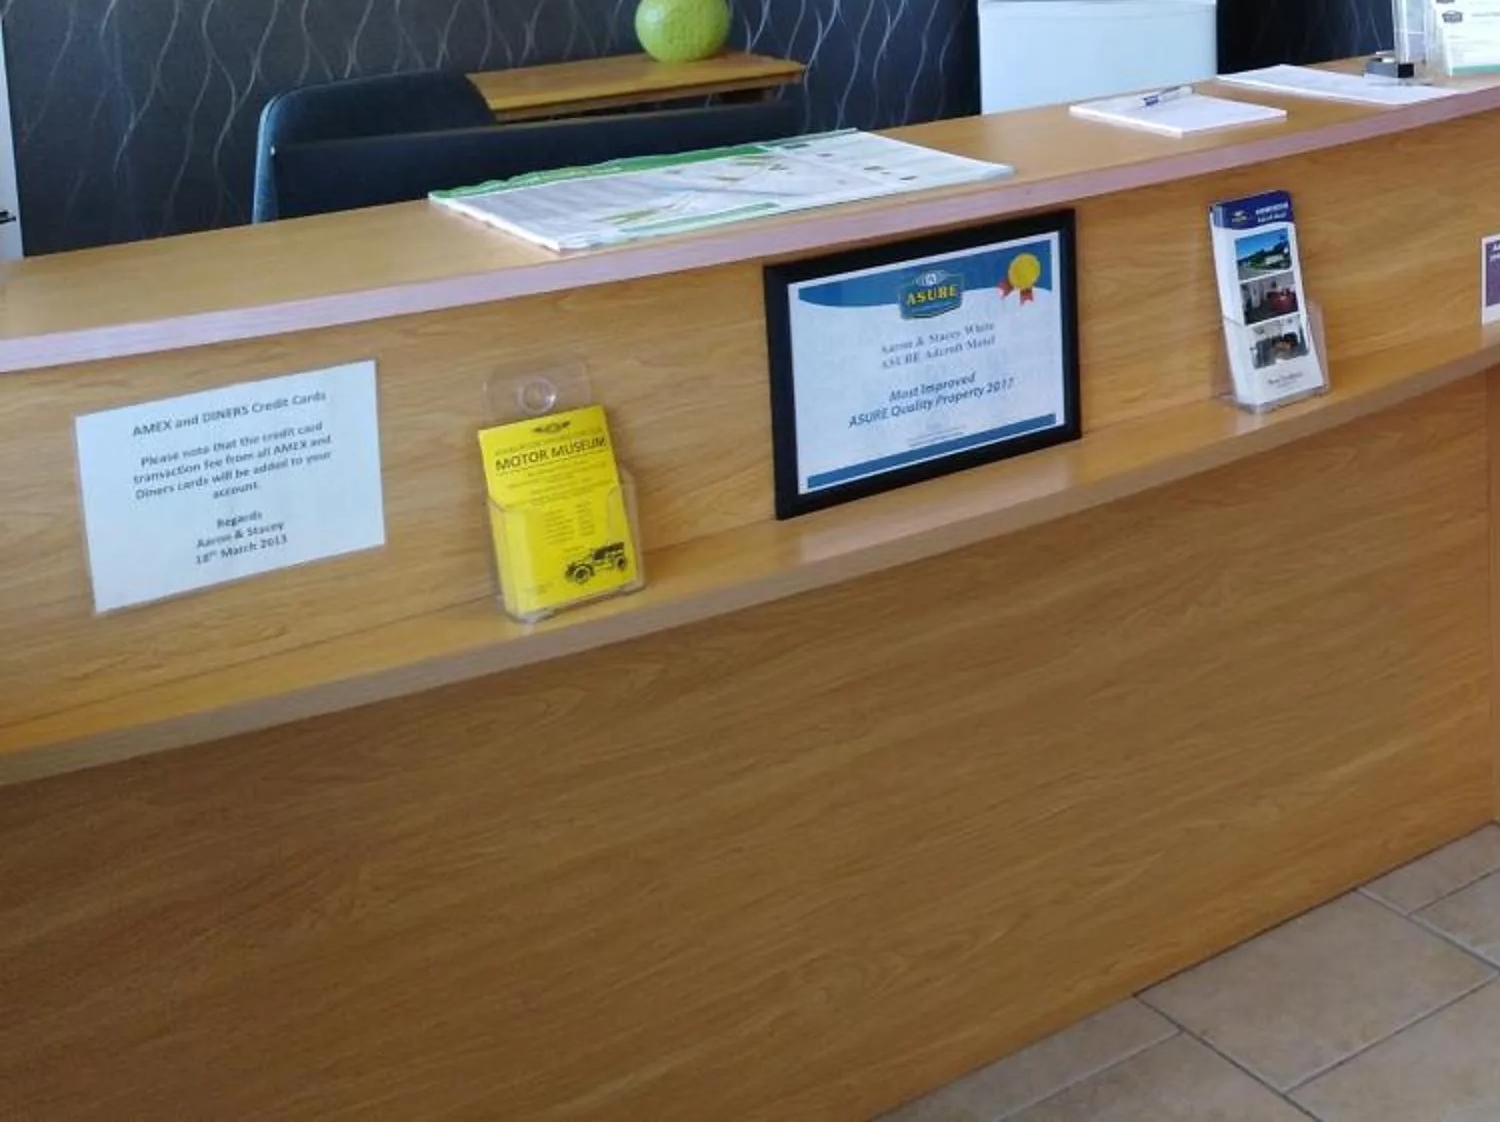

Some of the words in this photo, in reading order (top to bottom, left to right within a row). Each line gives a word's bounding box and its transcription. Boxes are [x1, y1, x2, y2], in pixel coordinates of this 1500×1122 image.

[906, 285, 959, 306] ASURE
[915, 336, 924, 348] &
[848, 408, 888, 428] ASURE
[891, 397, 933, 417] Quality
[935, 388, 984, 406] Property
[986, 378, 1014, 394] 2017
[889, 385, 919, 402] Most
[920, 373, 976, 395] Improved
[133, 421, 171, 437] AMEX
[176, 416, 199, 428] and
[203, 407, 249, 424] DINERS
[251, 398, 288, 414] Credit
[292, 390, 326, 407] Cards
[133, 462, 200, 484] transaction
[204, 457, 223, 471] fee
[226, 451, 253, 466] from
[257, 446, 270, 459] all
[273, 439, 307, 455] AMEX
[310, 434, 331, 447] and
[141, 451, 178, 467] Please
[183, 446, 210, 458] note
[214, 438, 237, 452] that
[240, 434, 260, 447] the
[263, 427, 294, 442] credit
[298, 422, 322, 436] card
[496, 448, 549, 471] MOTOR
[551, 437, 605, 457] MUSEUM
[136, 482, 174, 500] Diners
[177, 477, 208, 492] cards
[211, 471, 232, 485] will
[236, 466, 250, 480] be
[253, 458, 287, 475] added
[291, 456, 303, 468] to
[306, 450, 331, 466] your
[217, 510, 262, 529] Regards
[234, 529, 243, 539] &
[247, 521, 284, 537] Stacey
[221, 542, 257, 559] March
[261, 535, 287, 549] 2013
